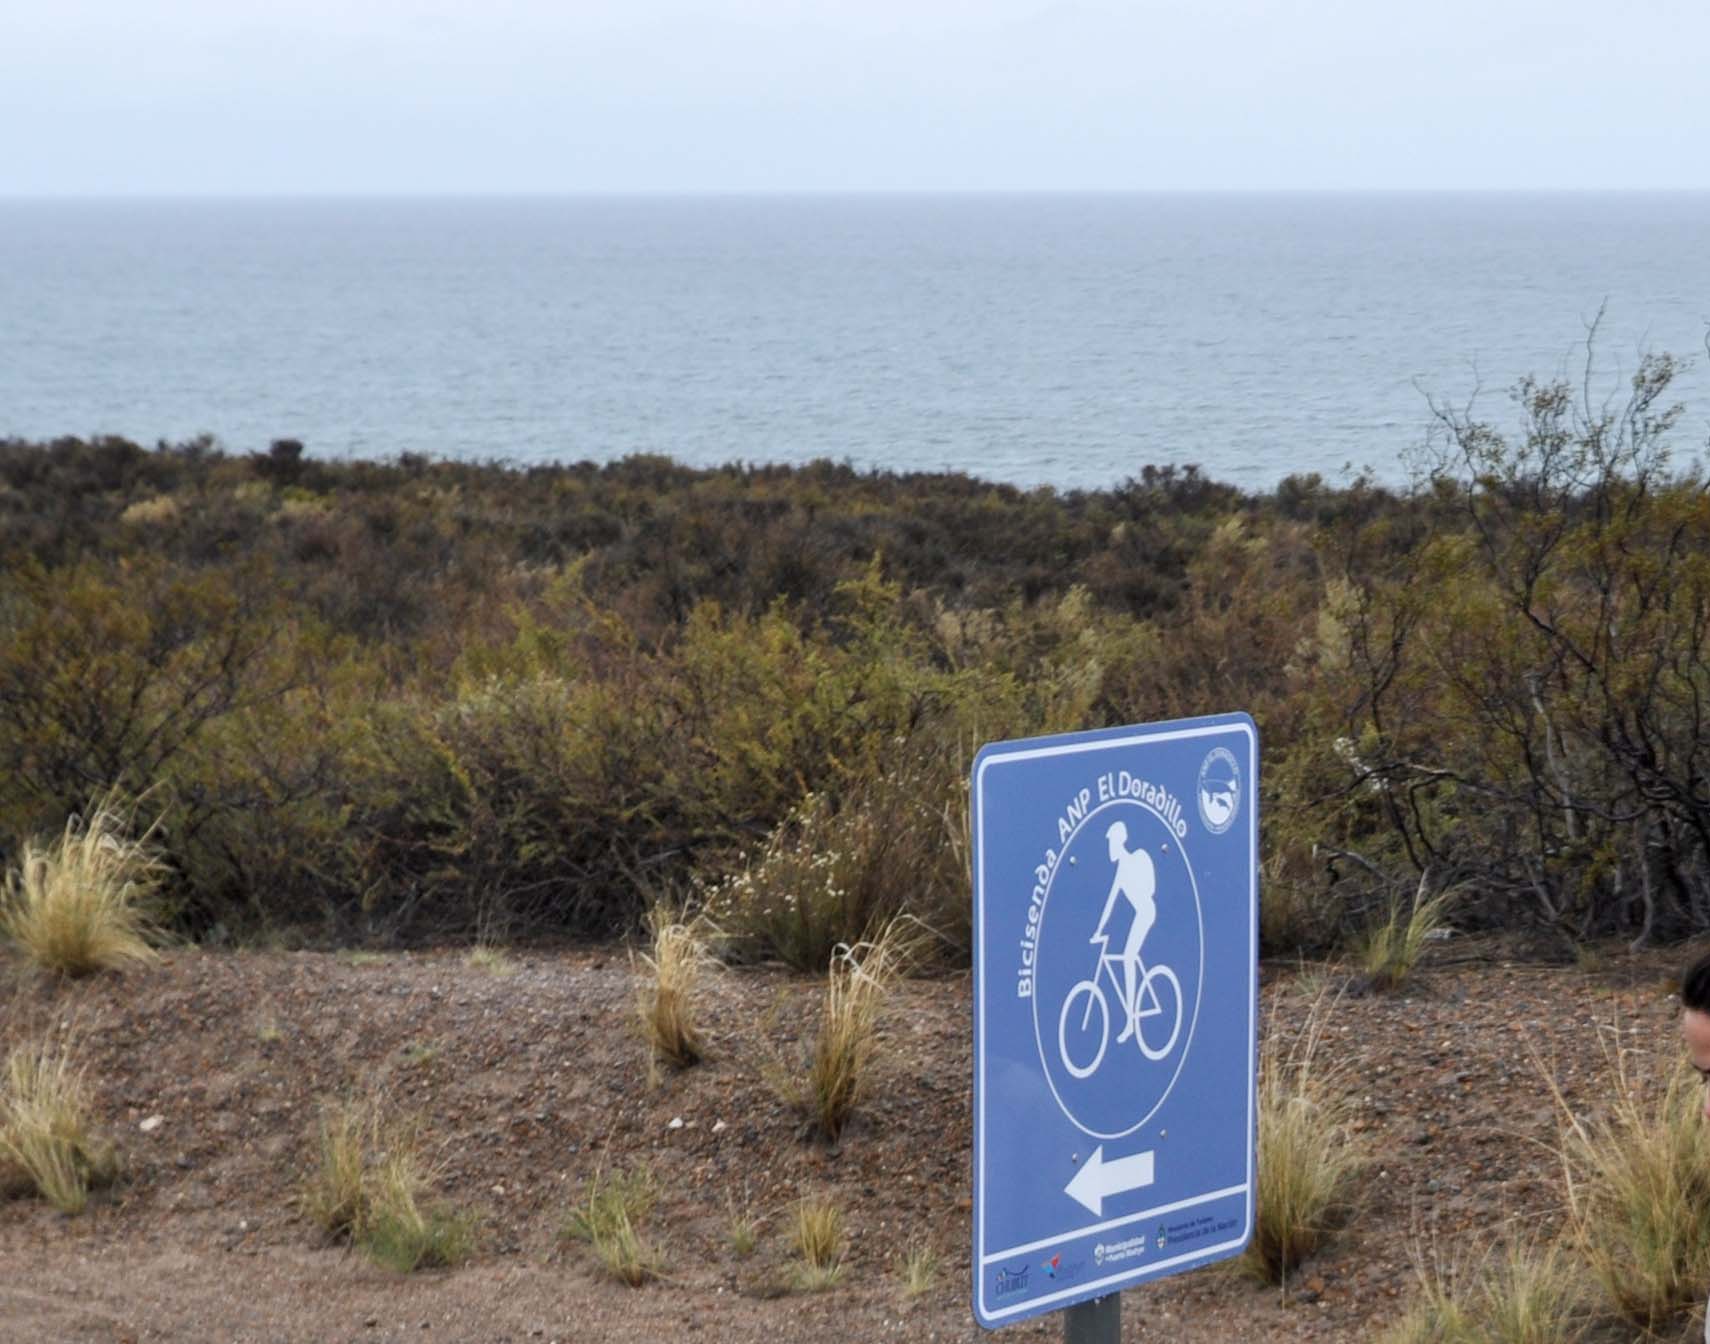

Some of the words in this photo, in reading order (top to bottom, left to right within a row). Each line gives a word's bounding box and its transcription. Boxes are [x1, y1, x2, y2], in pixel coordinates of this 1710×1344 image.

[1017, 849, 1057, 998] Bicisenda
[1057, 788, 1091, 844] ANP
[1097, 773, 1116, 801] El
[1118, 771, 1188, 839] Doradillo
